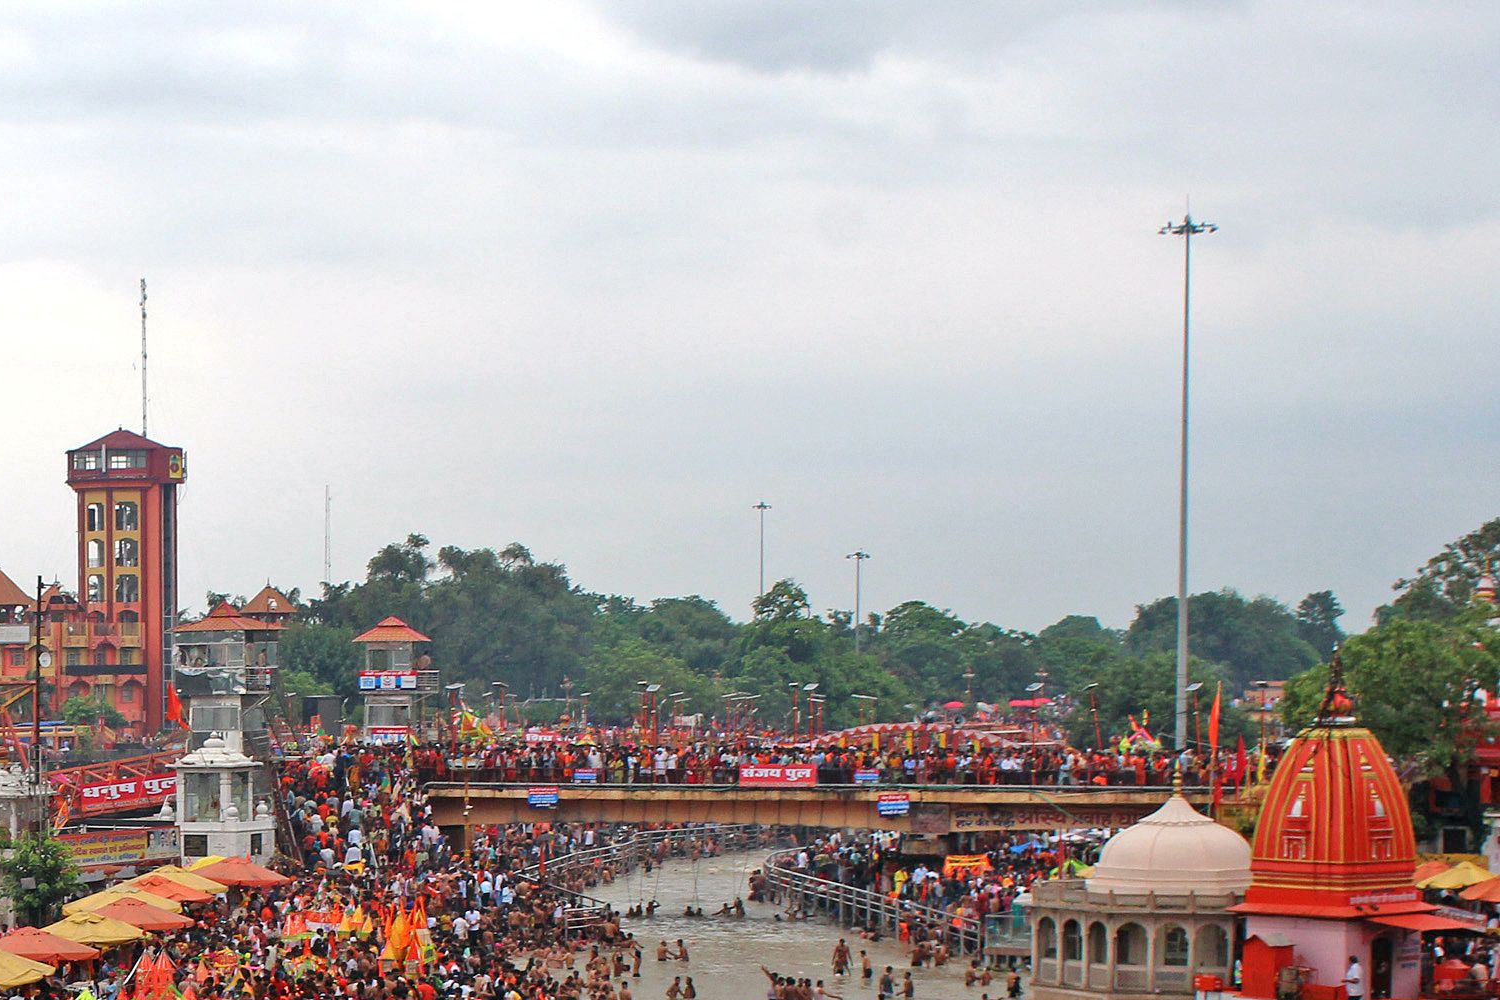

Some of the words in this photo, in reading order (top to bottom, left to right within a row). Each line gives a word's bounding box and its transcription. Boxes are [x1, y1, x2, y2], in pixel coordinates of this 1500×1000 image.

[741, 766, 782, 778] संजय
[785, 768, 813, 782] पुल
[82, 782, 137, 800] धनुष
